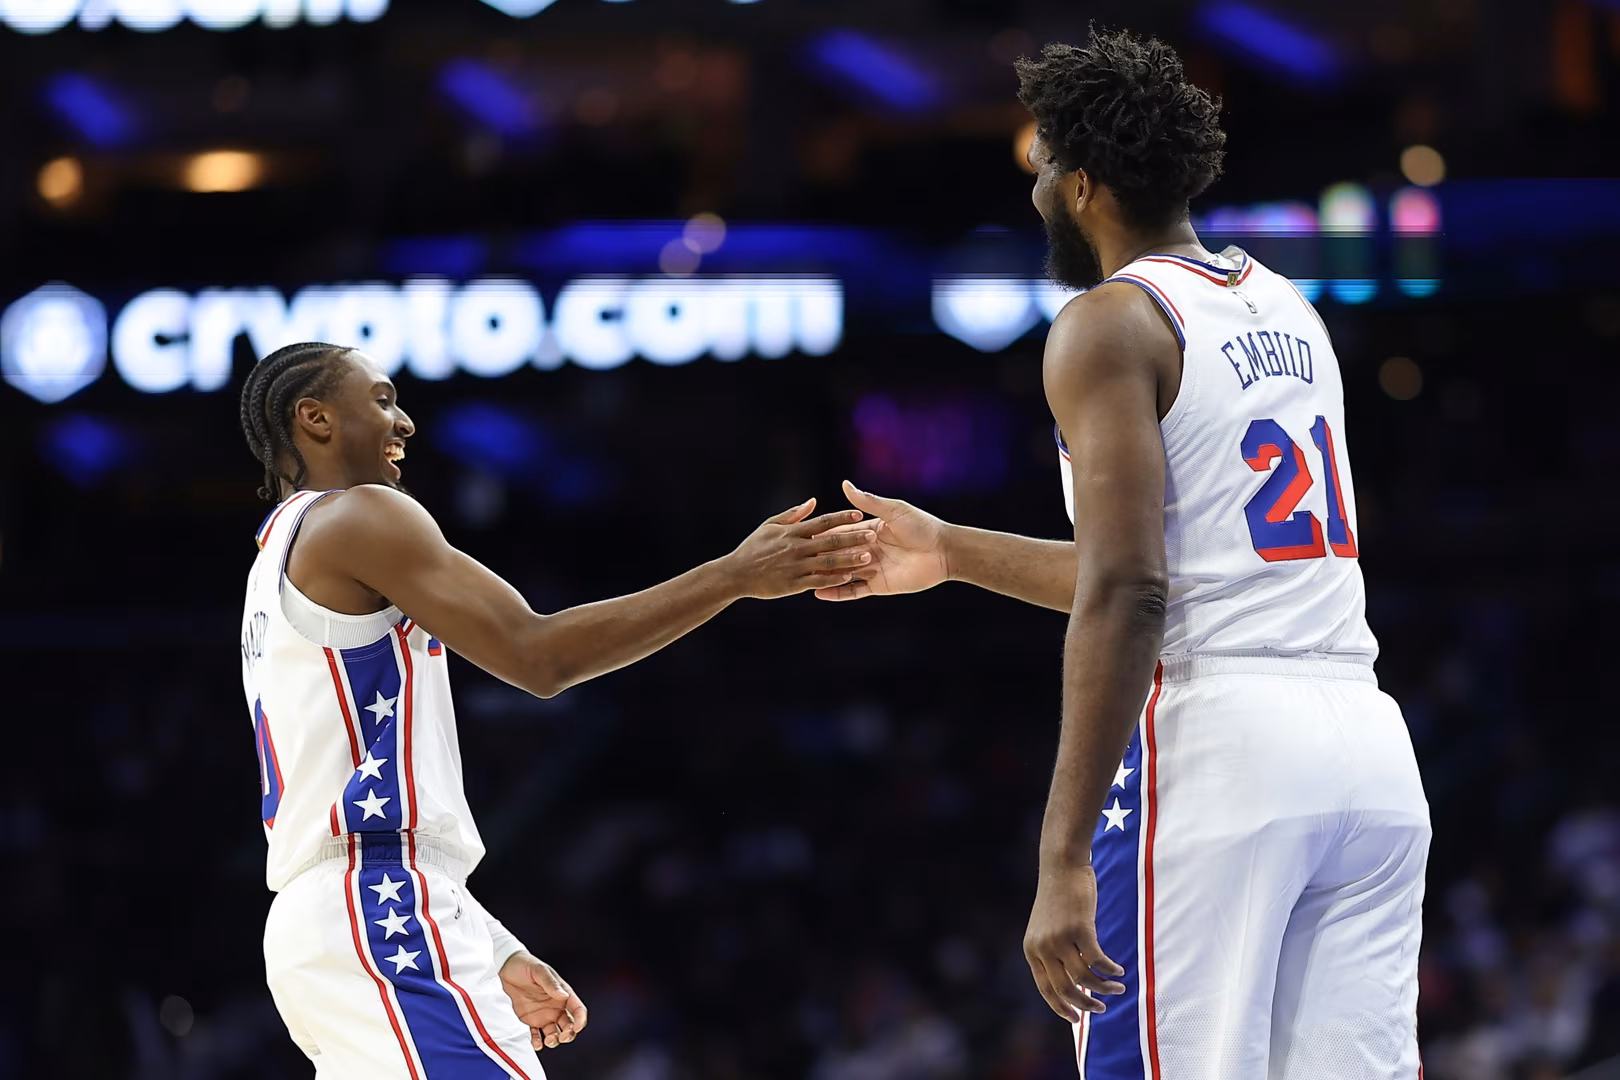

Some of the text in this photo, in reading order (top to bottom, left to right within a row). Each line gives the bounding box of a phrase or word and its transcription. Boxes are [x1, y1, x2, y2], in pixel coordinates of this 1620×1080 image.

[112, 274, 844, 393] crypto.com
[1221, 330, 1314, 391] EMBIID
[1240, 415, 1359, 562] 21
